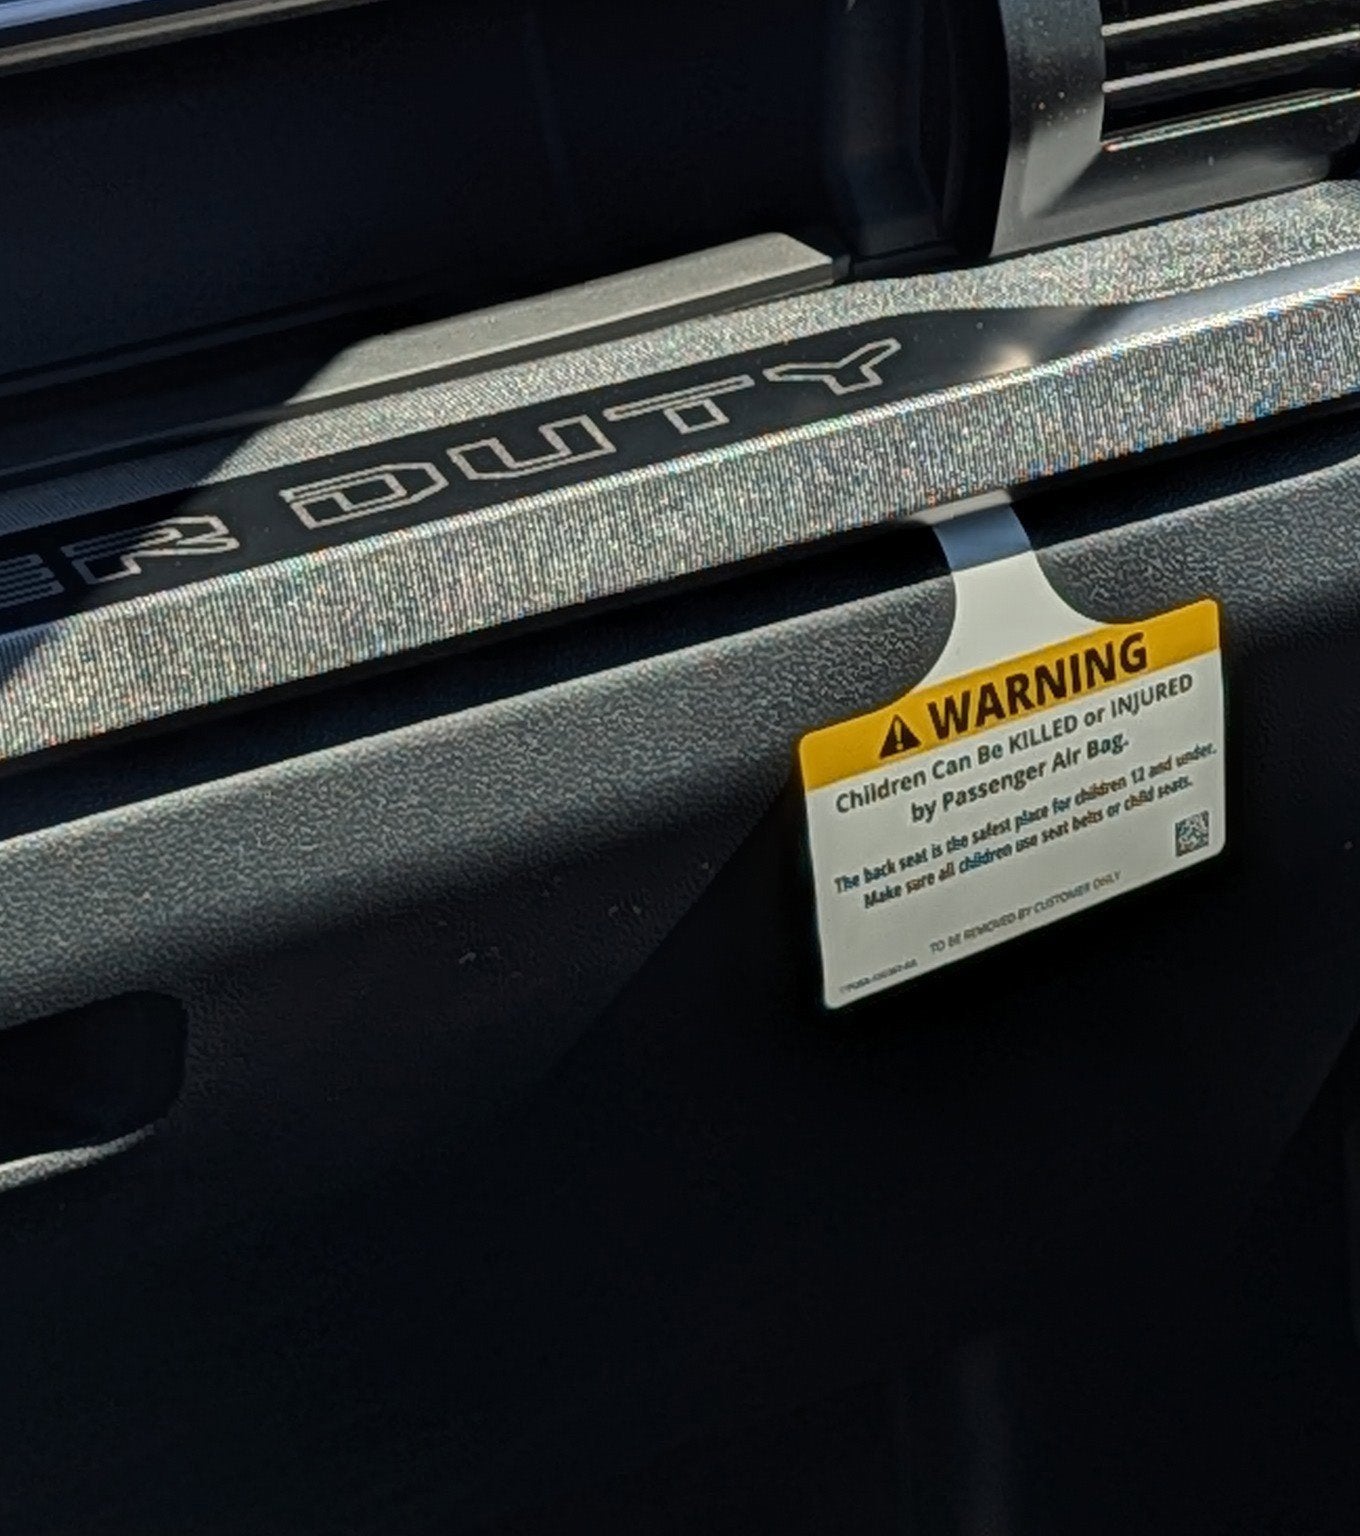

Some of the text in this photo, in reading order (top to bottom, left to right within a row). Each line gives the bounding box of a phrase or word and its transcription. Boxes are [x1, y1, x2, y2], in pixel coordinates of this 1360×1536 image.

[279, 337, 902, 531] DUTY
[836, 673, 1193, 813] Children Can Be KILLED or INJURED
[927, 632, 1147, 740] WARNING
[834, 741, 1218, 894] The back seat is the safest place for children 12 and under.
[910, 733, 1129, 824] by Passenger Air Bag.
[863, 883, 902, 910] Make
[904, 871, 936, 895] sure
[938, 861, 956, 882] all
[958, 842, 1013, 874] children
[1015, 834, 1038, 853] use
[1040, 820, 1070, 844] seat
[1071, 807, 1104, 831] belts
[1106, 801, 1121, 818] or
[1123, 785, 1155, 811] child
[929, 870, 1122, 955] TO BE REMOVED BY CUSTOMER ONLY
